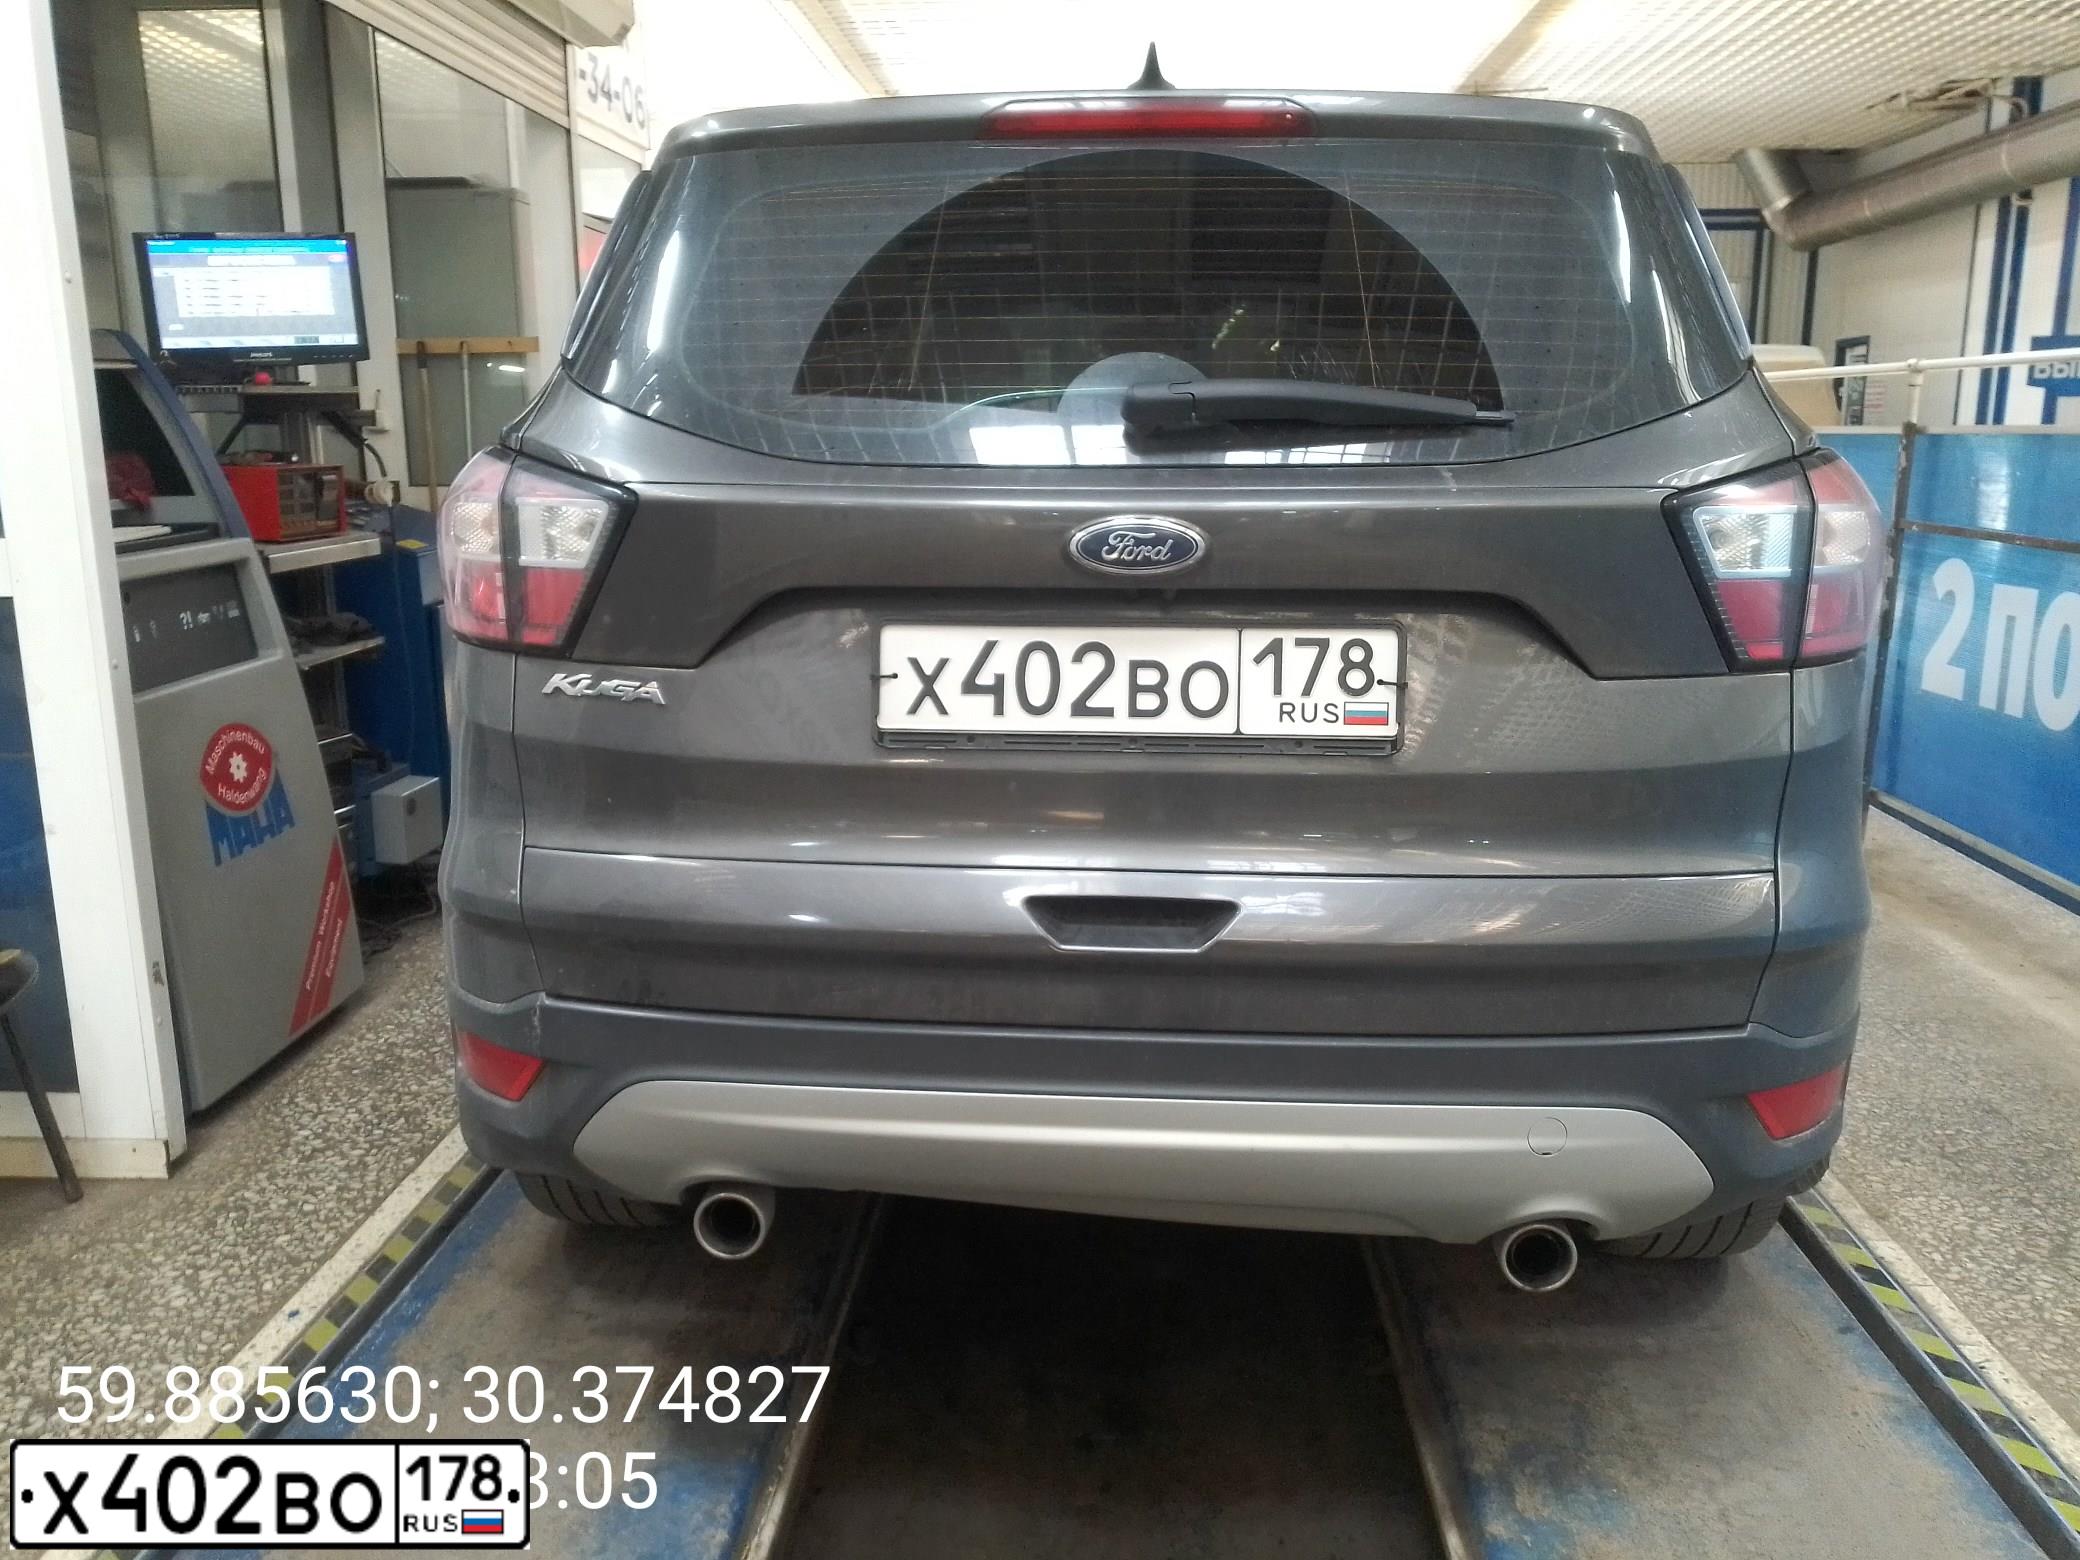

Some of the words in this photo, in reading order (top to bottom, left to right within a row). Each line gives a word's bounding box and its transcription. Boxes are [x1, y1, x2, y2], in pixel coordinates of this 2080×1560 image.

[2032, 360, 2080, 379] ВЫ
[1101, 530, 1174, 561] Ford
[1920, 558, 1975, 701] 2
[1252, 637, 1375, 697] 178
[541, 673, 666, 705] KUGA
[1279, 702, 1340, 724] RUS
[204, 730, 265, 775] Maschinenbau
[217, 767, 267, 805] Haldenwang
[204, 765, 295, 868] MAHA
